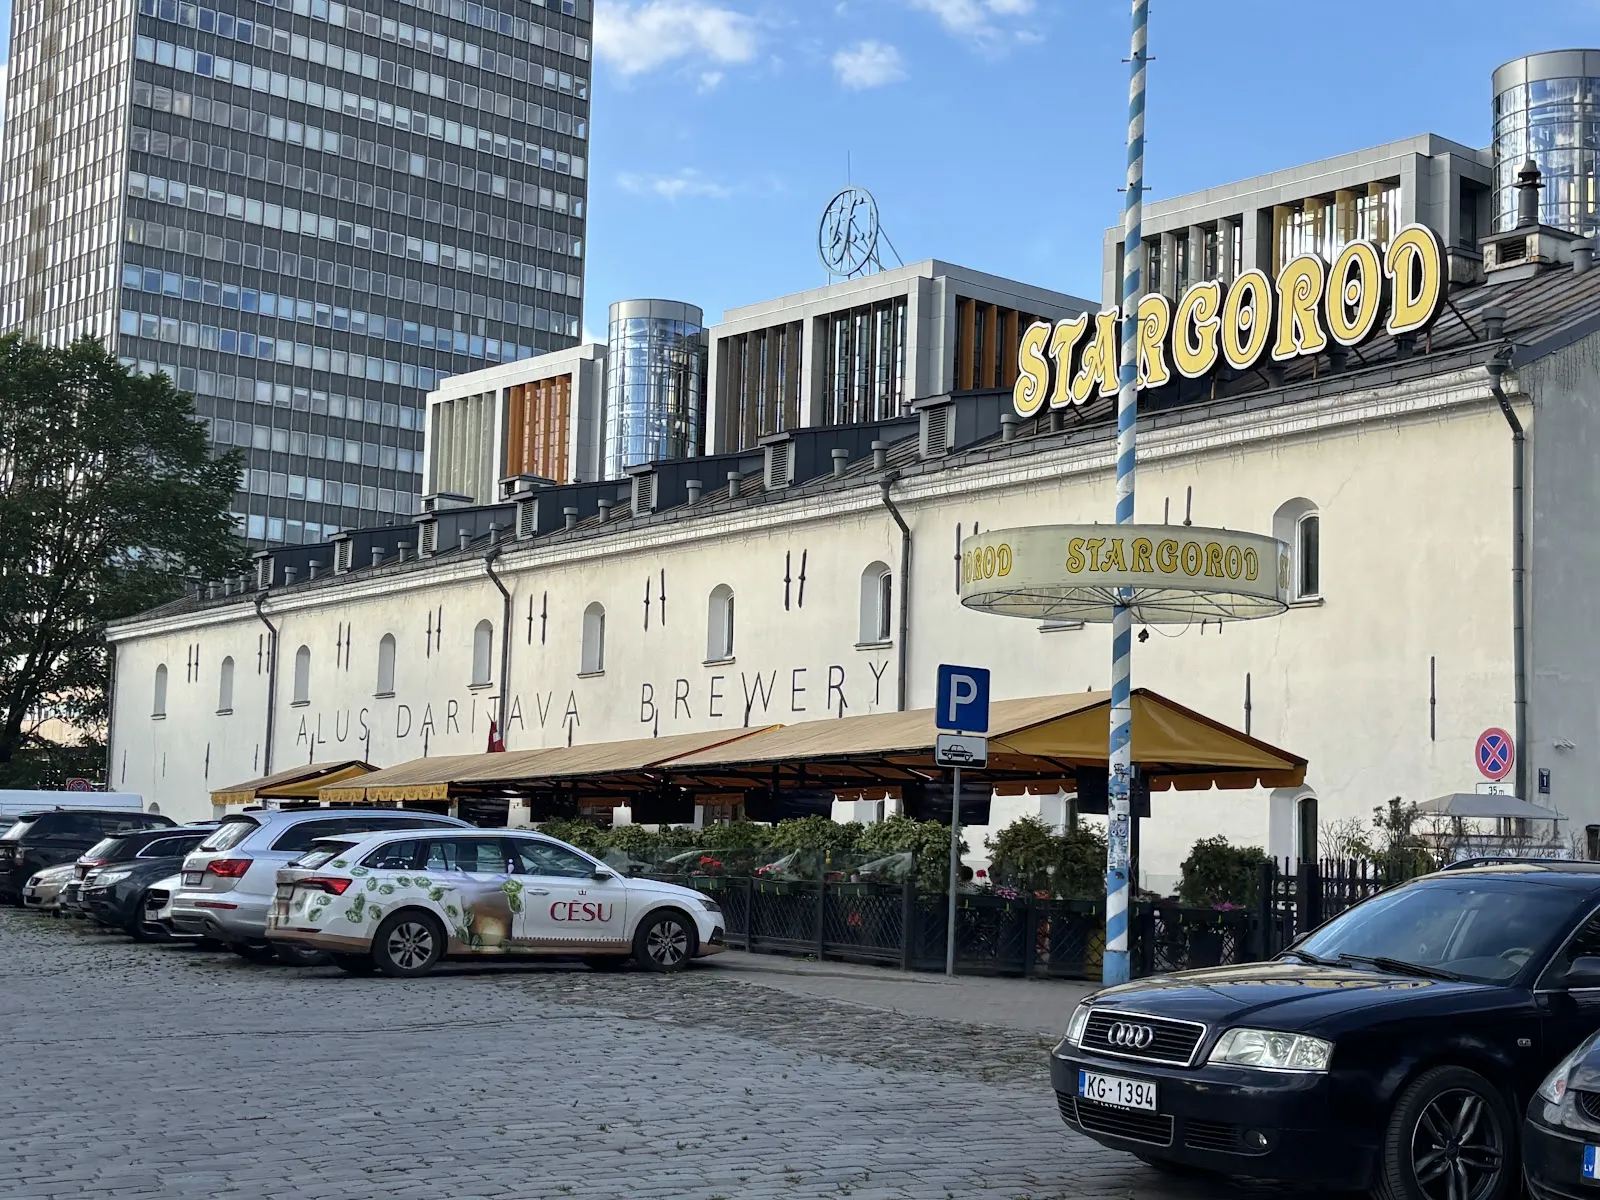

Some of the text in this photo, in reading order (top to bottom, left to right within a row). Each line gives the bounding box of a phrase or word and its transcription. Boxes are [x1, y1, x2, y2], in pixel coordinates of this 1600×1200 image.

[1013, 222, 1444, 418] STARGOROD
[963, 543, 1013, 584] OROD
[1066, 537, 1260, 581] STARGOROD
[296, 708, 370, 746] ALUS
[640, 660, 889, 723] BREWERY
[948, 673, 978, 722] P
[550, 900, 613, 922] CĒSU
[1087, 1075, 1154, 1108] KG-1394
[1584, 1164, 1593, 1172] LV
